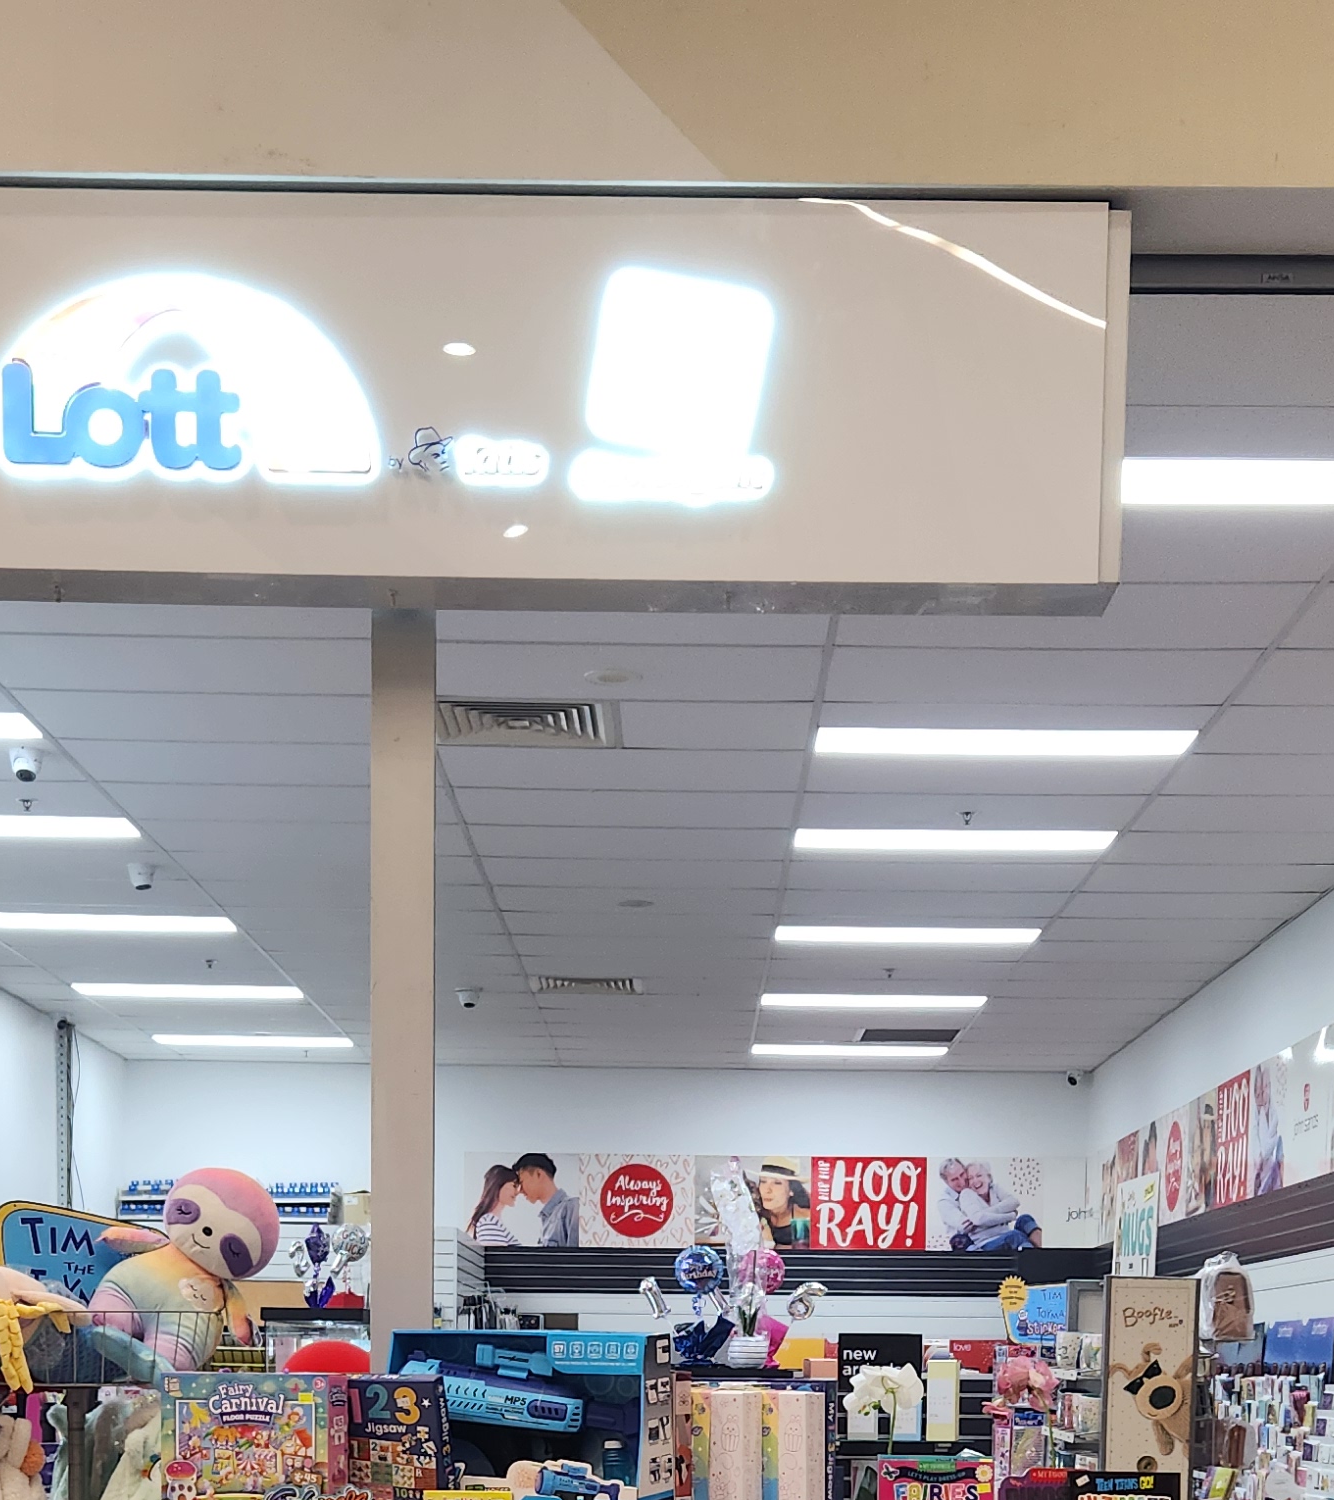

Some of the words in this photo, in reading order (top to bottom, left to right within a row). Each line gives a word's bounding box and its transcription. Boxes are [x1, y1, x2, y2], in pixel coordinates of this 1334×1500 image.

[1, 359, 241, 471] Lott
[388, 455, 405, 472] by
[614, 1174, 663, 1196] Always
[830, 1160, 922, 1202] HOO
[605, 1190, 669, 1212] Inspiring
[816, 1201, 919, 1250] RAY!
[1121, 1205, 1154, 1257] MUGS
[19, 1216, 96, 1257] TIM
[62, 1261, 96, 1276] THE
[1040, 1289, 1063, 1300] TIM
[1122, 1306, 1173, 1328] Boofle
[842, 1349, 877, 1361] new
[953, 1343, 972, 1352] love
[217, 1381, 254, 1398] Fairy
[208, 1393, 285, 1416] Carnival
[365, 1383, 392, 1419] 2
[393, 1386, 421, 1425] 3
[504, 1394, 527, 1406] MP5
[222, 1414, 245, 1422] FLOOR
[245, 1414, 271, 1423] PUZZLE
[364, 1422, 407, 1436] Jigsaw
[1095, 1478, 1114, 1491] TEEN
[1139, 1476, 1154, 1490] GO!
